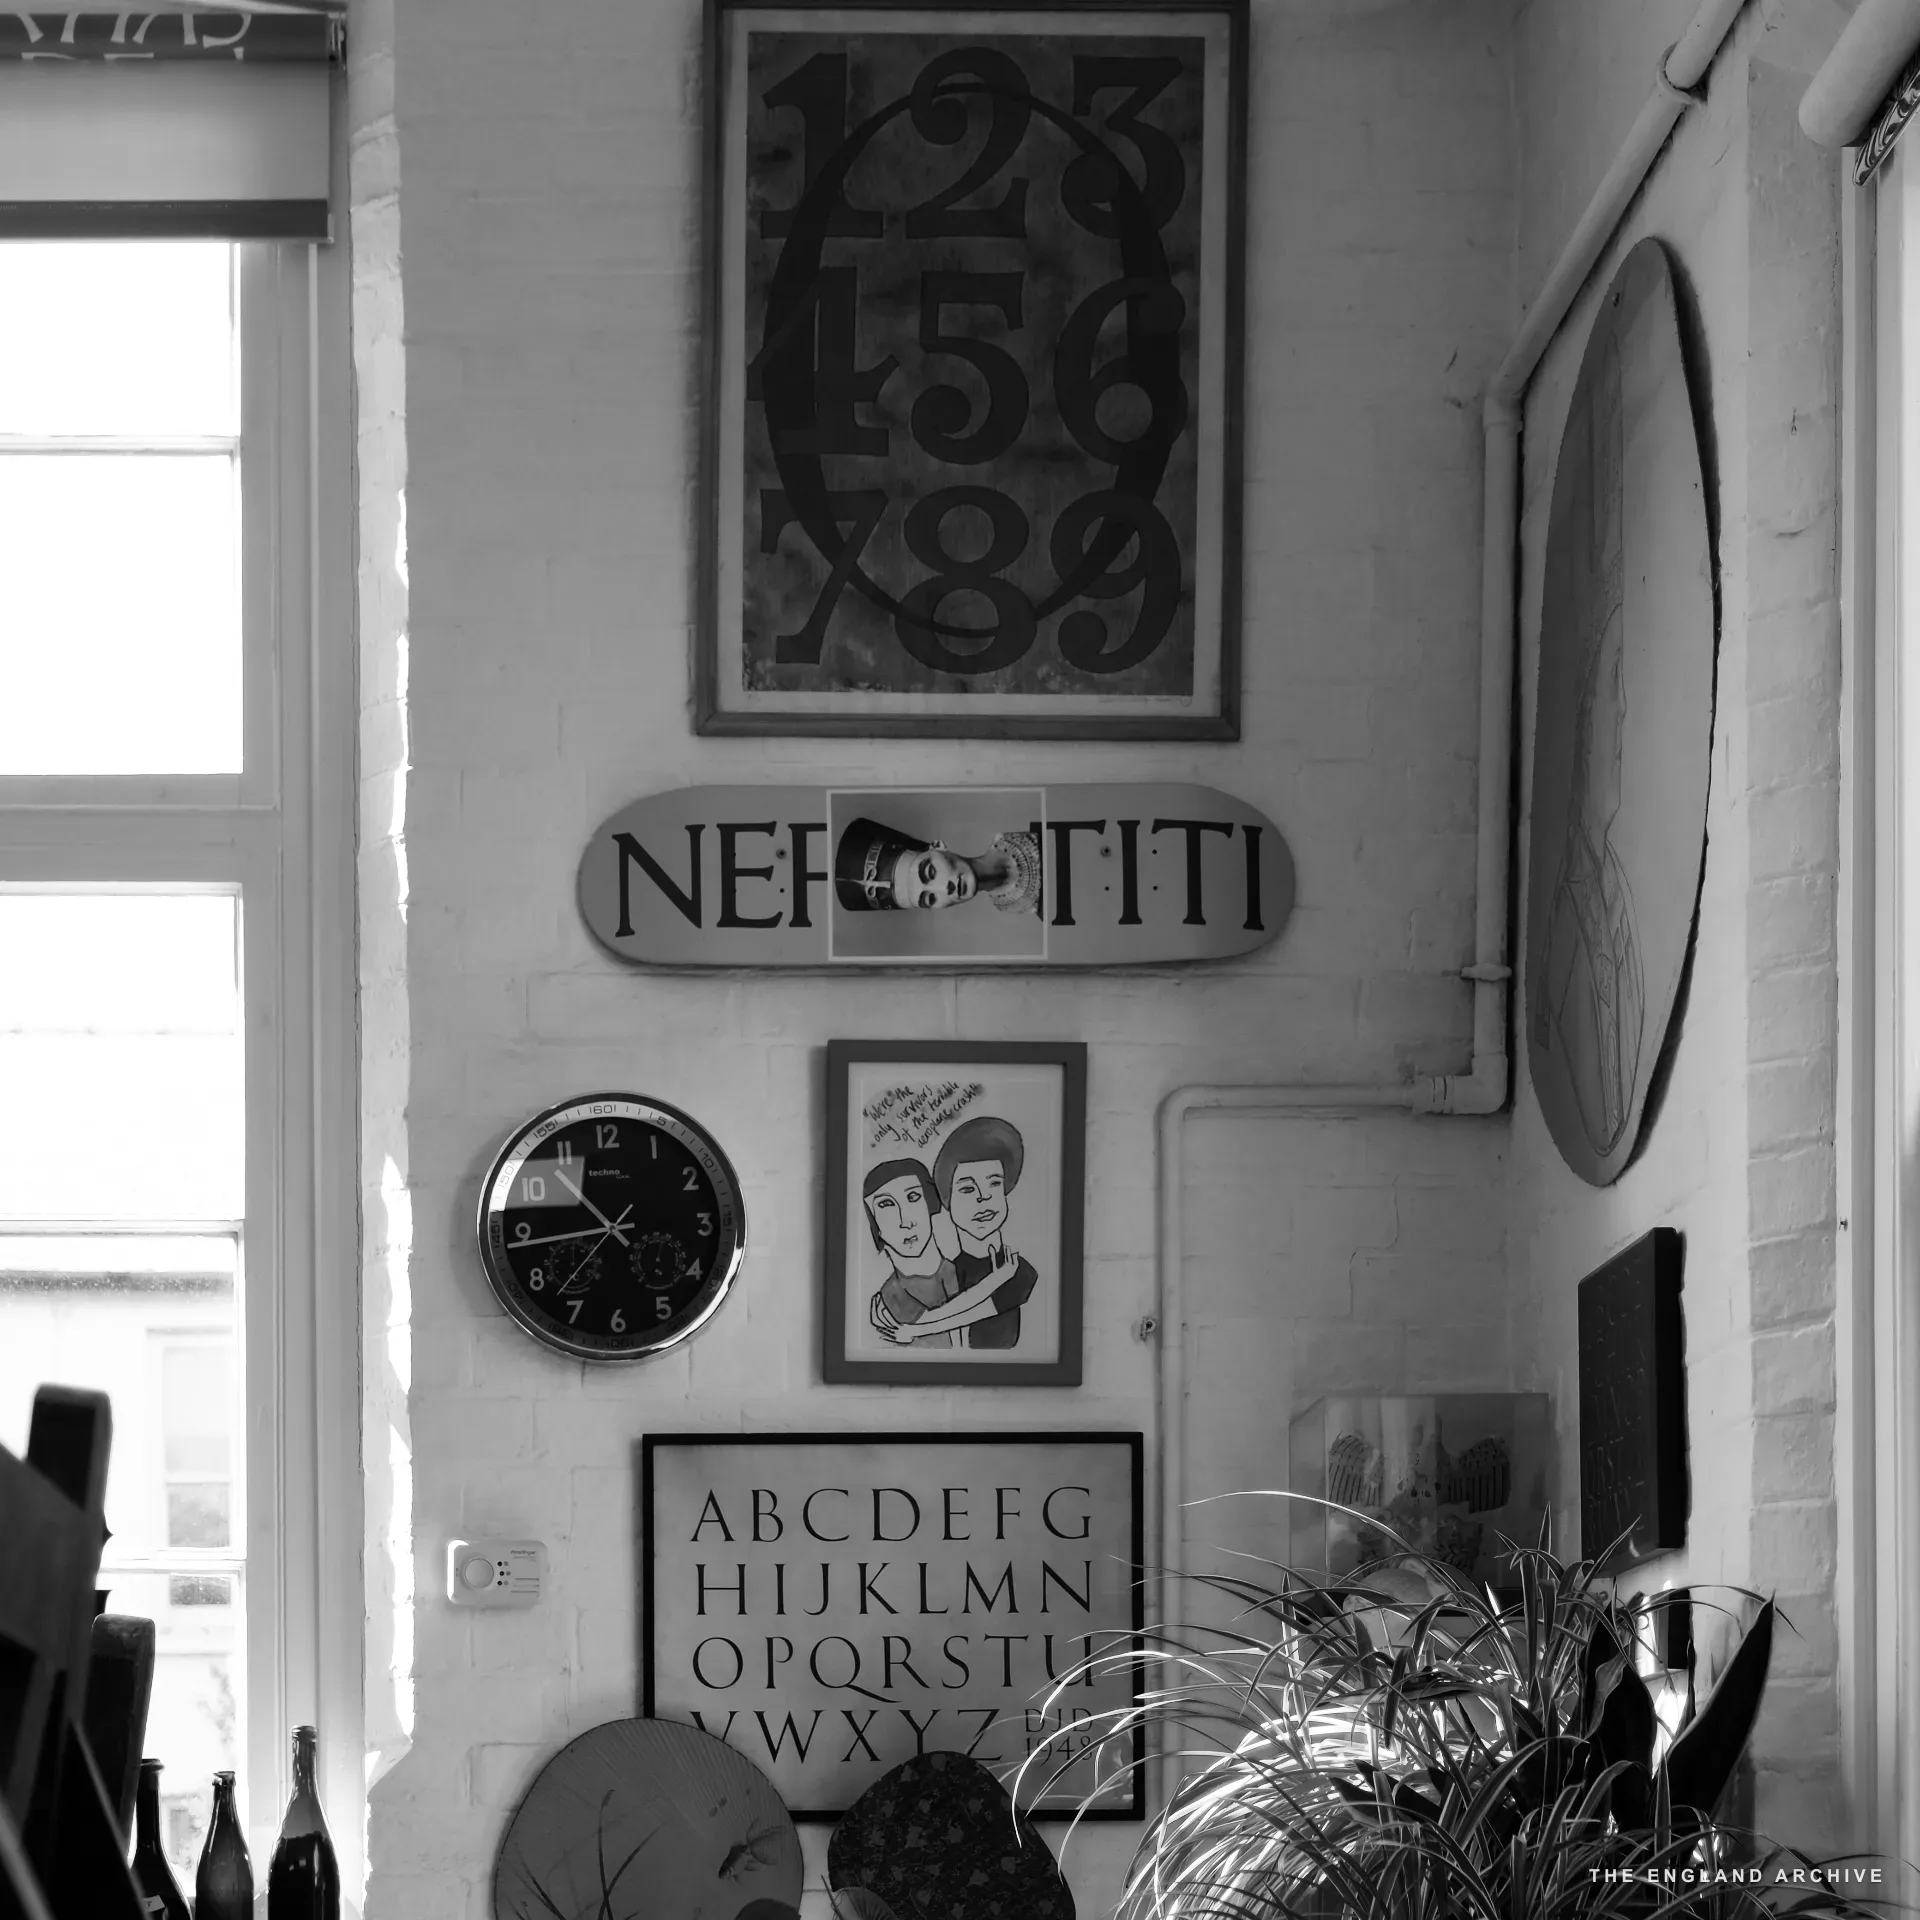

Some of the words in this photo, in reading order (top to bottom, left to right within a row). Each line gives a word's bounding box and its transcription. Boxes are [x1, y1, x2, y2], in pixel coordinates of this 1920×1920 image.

[894, 1085, 914, 1102] the
[593, 1104, 613, 1115] 60
[656, 1115, 668, 1127] 5
[875, 1123, 901, 1142] only
[896, 1084, 933, 1123] survivors
[537, 1121, 557, 1138] 55
[596, 1124, 620, 1149] 12
[902, 1128, 916, 1143] of
[912, 1113, 929, 1130] the
[556, 1141, 572, 1166] 11
[650, 1135, 657, 1160] 1
[588, 1168, 621, 1177] techno
[682, 1166, 699, 1191] 2
[521, 1177, 545, 1202] 10
[515, 1222, 532, 1242] 9
[696, 1212, 713, 1236] 3
[530, 1267, 545, 1291] 8
[685, 1257, 703, 1281] 4
[566, 1300, 584, 1324] 7
[656, 1296, 672, 1320] 5
[610, 1308, 626, 1333] 6
[1025, 1735, 1093, 1767] 1948
